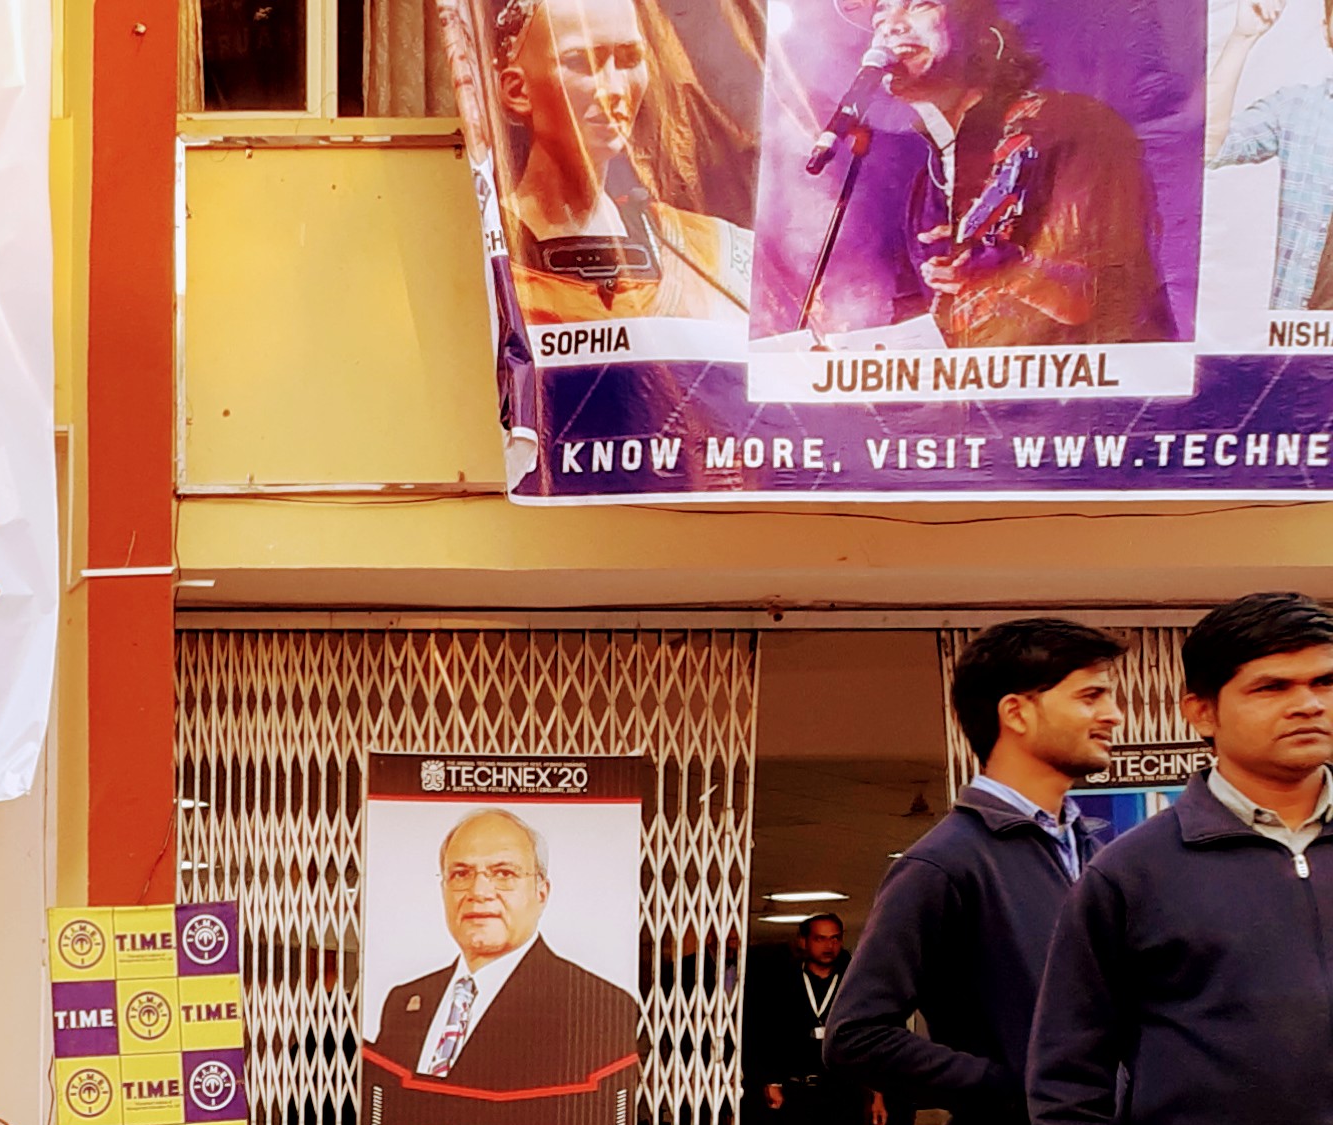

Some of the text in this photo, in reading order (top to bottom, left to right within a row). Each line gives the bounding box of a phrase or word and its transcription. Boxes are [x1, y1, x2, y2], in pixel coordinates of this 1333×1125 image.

[540, 326, 631, 356] SOPHIA
[1268, 321, 1333, 347] NISH
[812, 352, 1120, 393] JUBIN NAUTIYAL
[562, 437, 683, 473] KNOW
[706, 437, 841, 473] MORE,
[866, 434, 986, 472] VISIT
